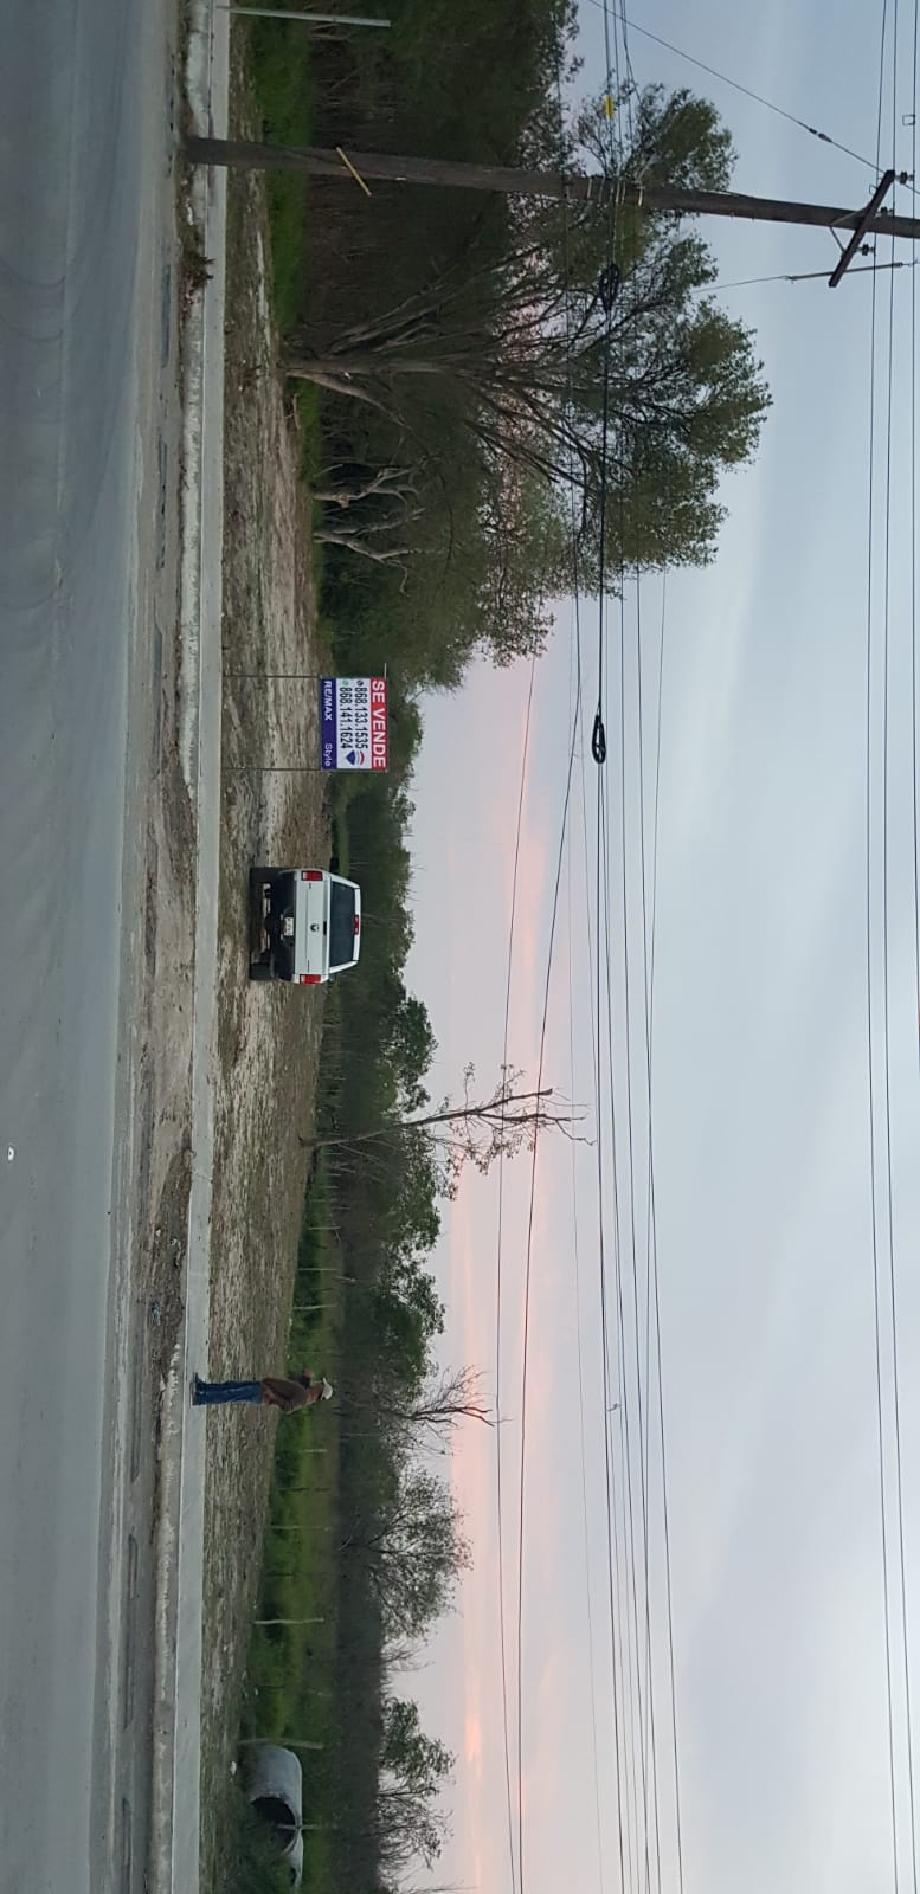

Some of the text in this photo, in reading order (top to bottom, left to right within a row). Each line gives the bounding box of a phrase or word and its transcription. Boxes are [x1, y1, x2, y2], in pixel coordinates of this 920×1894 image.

[340, 687, 353, 749] 868.141.1624
[354, 687, 368, 749] 868.133.1535
[372, 681, 386, 768] SE VENDE
